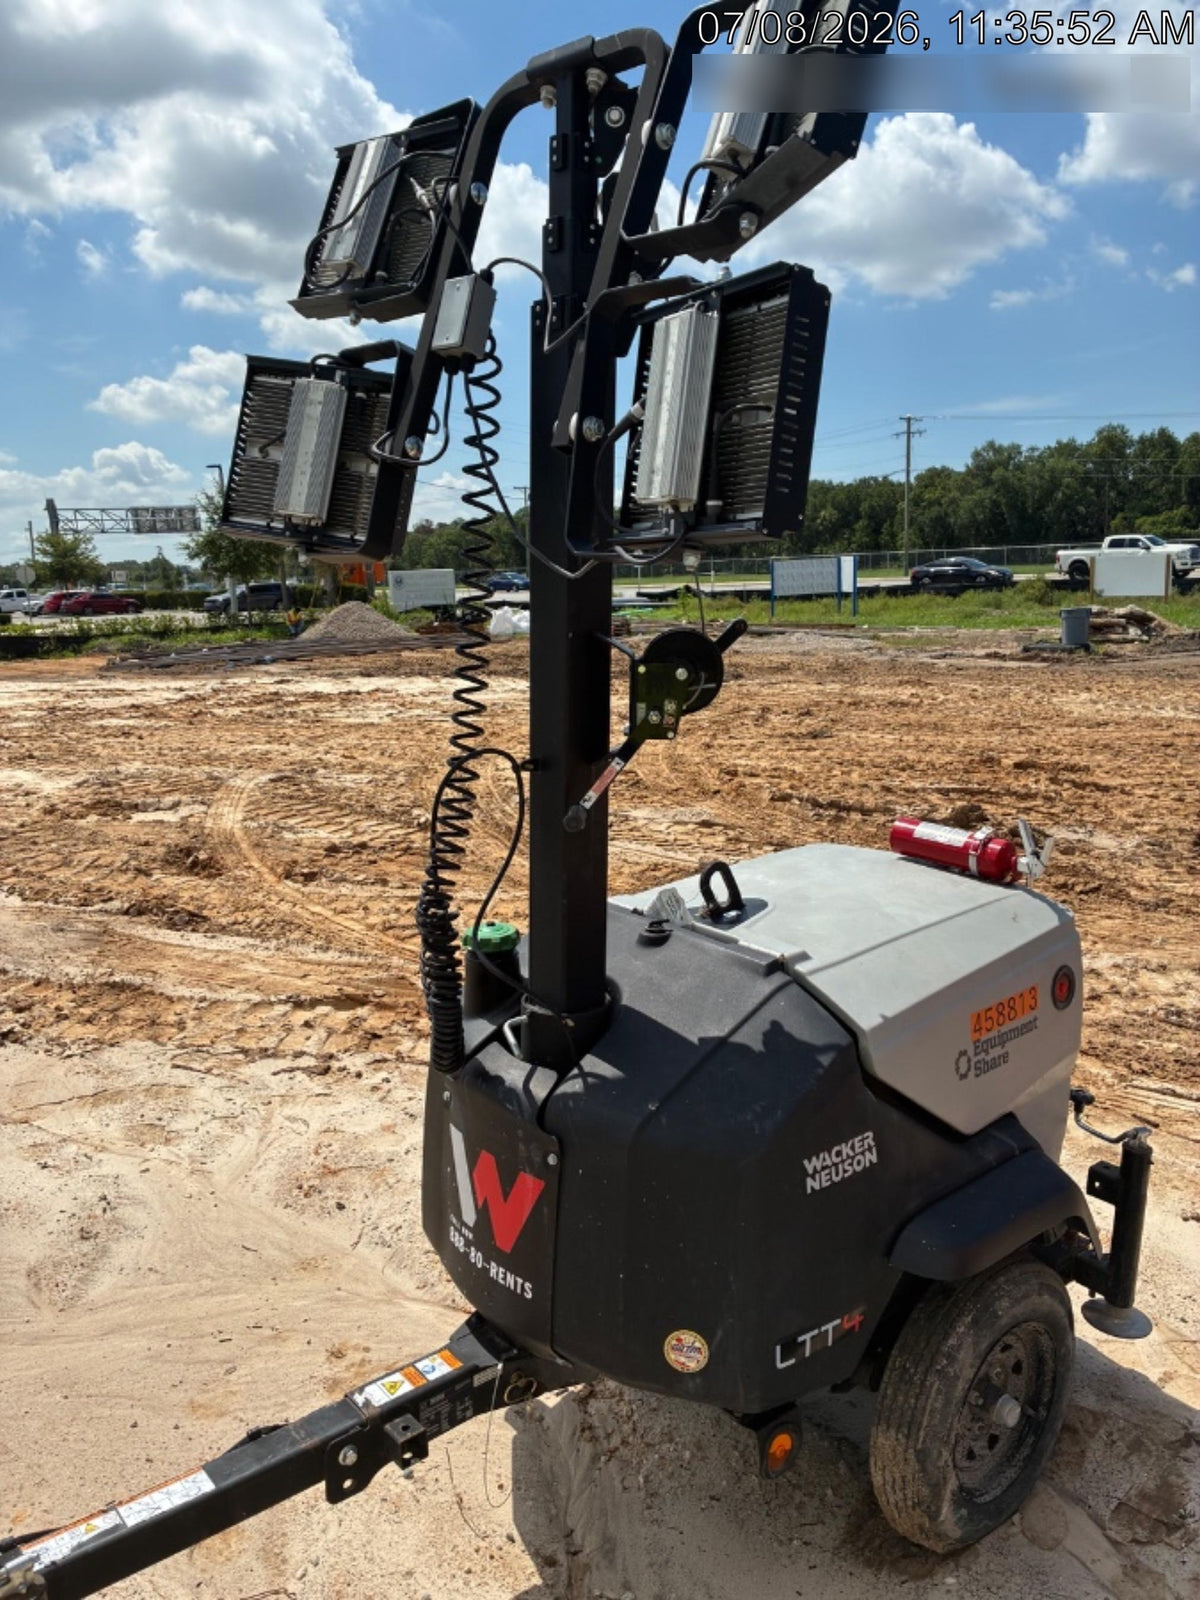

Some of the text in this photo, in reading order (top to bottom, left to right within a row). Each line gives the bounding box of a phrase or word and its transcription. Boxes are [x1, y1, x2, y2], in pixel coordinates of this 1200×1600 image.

[972, 985, 1038, 1037] 458813
[973, 1014, 1038, 1057] Equipment
[973, 1049, 1009, 1078] Share
[802, 1130, 876, 1176] WACKER
[805, 1146, 878, 1195] NEUSON
[774, 1311, 865, 1370] LTT4
